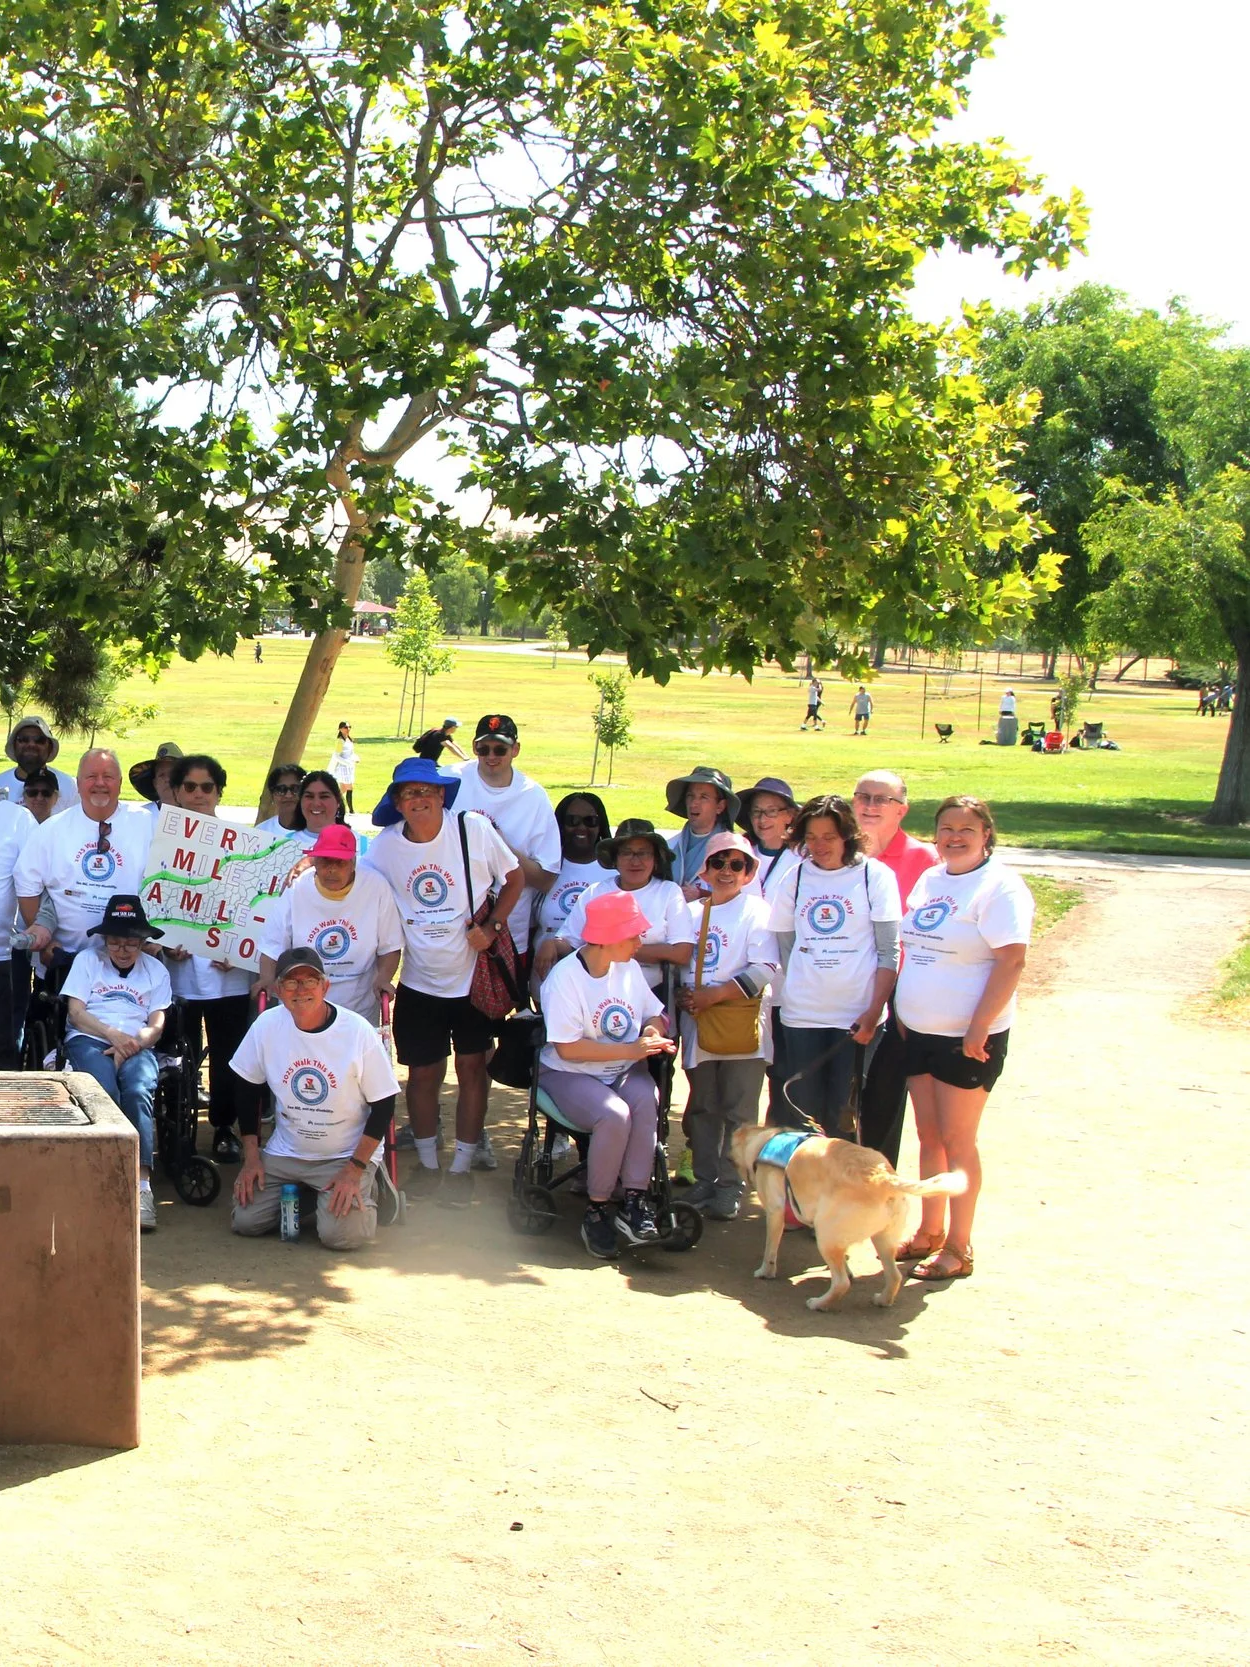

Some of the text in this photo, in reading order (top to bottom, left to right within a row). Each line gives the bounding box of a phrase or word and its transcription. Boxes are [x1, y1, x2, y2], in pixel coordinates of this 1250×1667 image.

[163, 811, 258, 855] EVERY
[172, 848, 244, 886] MILE
[412, 865, 427, 876] Walk
[429, 864, 442, 873] This
[444, 871, 455, 886] Way
[147, 882, 162, 904] A
[563, 881, 580, 889] Walk
[844, 899, 854, 915] Way
[307, 928, 320, 943] 2025
[319, 920, 337, 928] Walk
[349, 925, 358, 941] Way
[205, 927, 260, 963] STO
[613, 997, 626, 1006] This
[282, 1058, 338, 1089] 2025 Walk This Way
